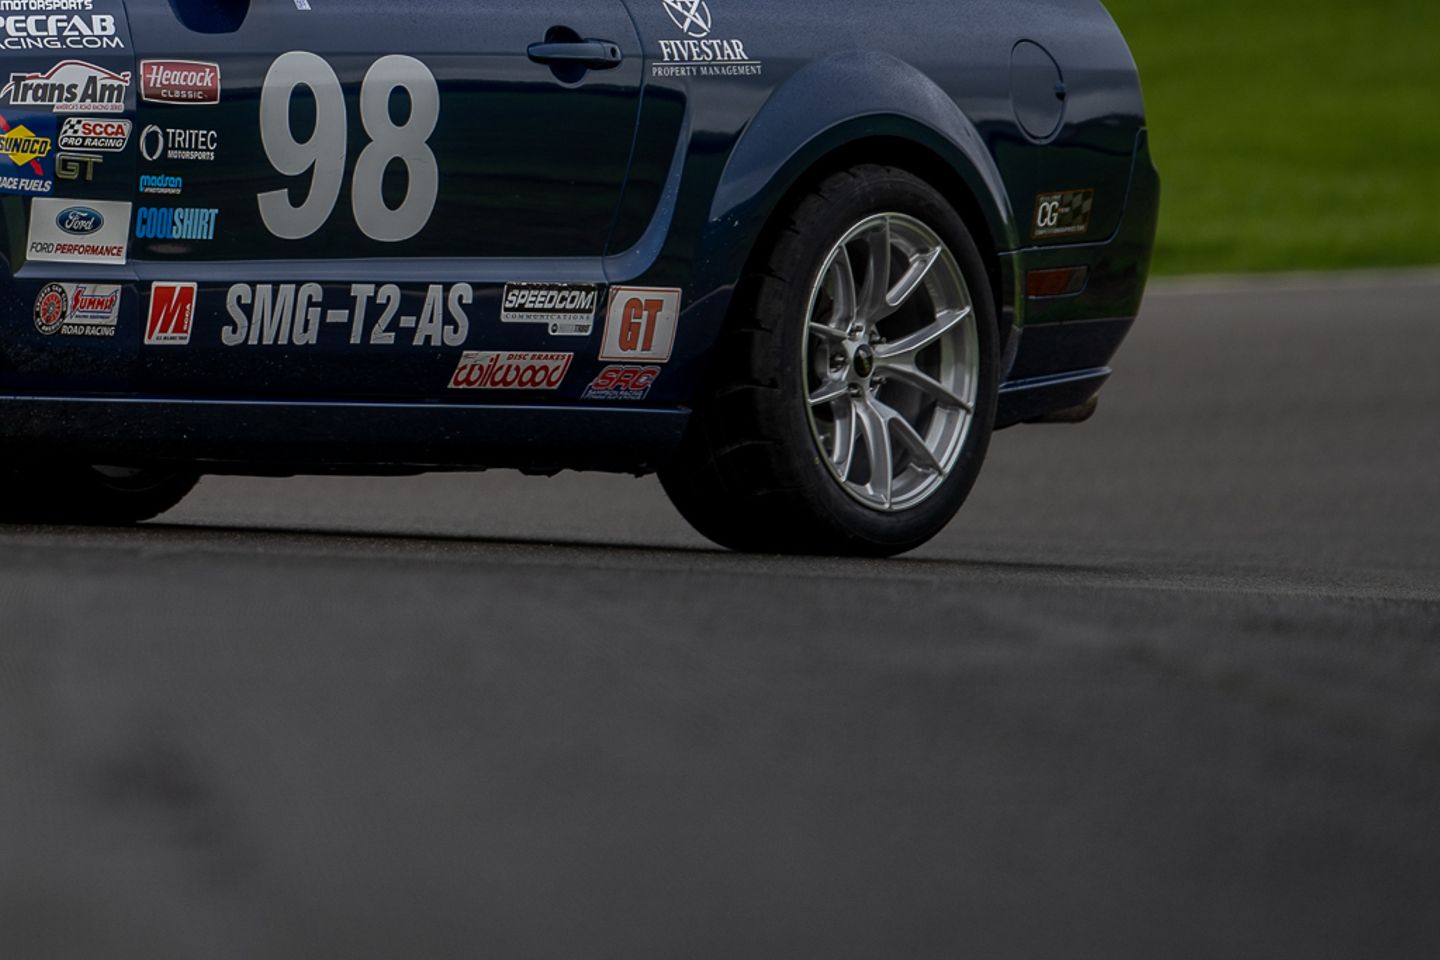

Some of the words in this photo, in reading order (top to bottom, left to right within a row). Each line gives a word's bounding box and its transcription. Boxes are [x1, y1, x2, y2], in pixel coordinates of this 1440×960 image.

[658, 39, 749, 61] FIVESTAR
[146, 65, 215, 88] Heacock
[652, 66, 697, 77] PROPERTY
[700, 65, 762, 76] MANAGEMENT
[10, 76, 79, 103] Trans
[79, 76, 124, 103] Am
[161, 90, 203, 99] CLASSIC
[82, 123, 125, 136] SCCA
[166, 128, 218, 150] TRITEC
[61, 137, 82, 146] PRO
[84, 138, 124, 148] RACING
[257, 50, 440, 243] 98
[55, 152, 103, 180] GT
[167, 150, 215, 160] MOTORSPORTS
[19, 177, 52, 192] FUELS
[65, 211, 95, 230] Ford
[136, 207, 219, 240] COOLSHIRT
[30, 241, 55, 253] FORD
[55, 243, 124, 257] PERFORMANCE
[505, 289, 593, 309] SPEEDCOM
[183, 303, 191, 330] SCCA
[221, 282, 473, 346] SMG-T2-AS
[619, 298, 664, 351] GT
[61, 325, 84, 335] ROAD
[85, 325, 116, 336] RACING
[507, 353, 528, 361] DISC
[530, 353, 566, 361] BRAKES
[452, 353, 571, 387] wilwood
[592, 367, 658, 390] SRC
